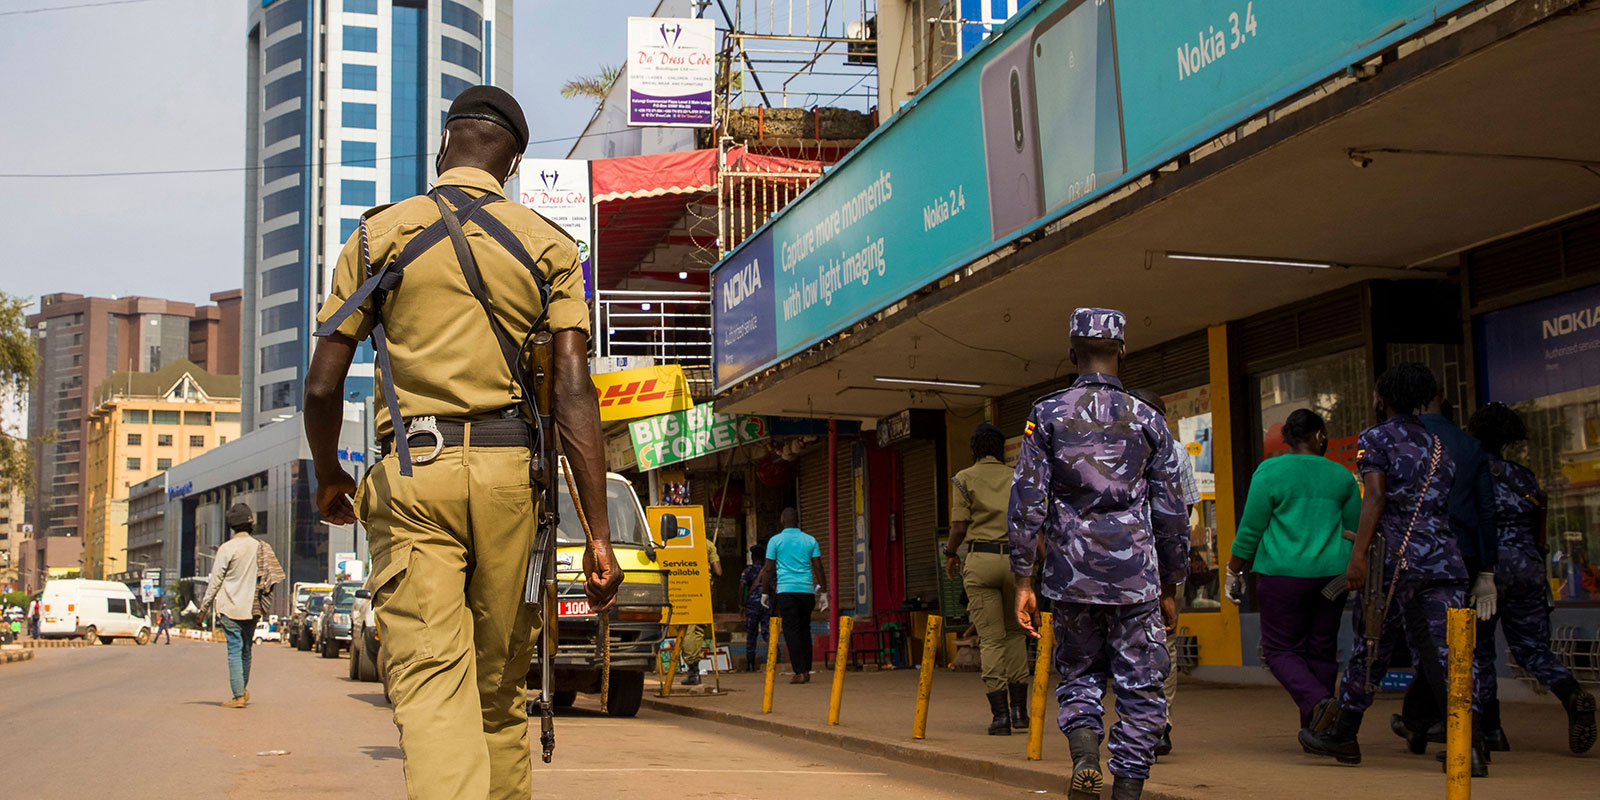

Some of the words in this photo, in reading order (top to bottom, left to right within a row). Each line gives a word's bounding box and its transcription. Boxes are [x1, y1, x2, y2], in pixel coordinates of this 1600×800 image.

[660, 51, 685, 65] Dress
[688, 52, 711, 65] Code
[1177, 26, 1226, 81] Nokia
[1229, 2, 1257, 51] 3.4
[541, 191, 563, 204] Dress
[566, 191, 587, 204] Code
[923, 196, 950, 233] Nokia
[950, 185, 966, 218] 2.4
[781, 229, 814, 275] Capture
[815, 214, 840, 249] more
[841, 169, 893, 230] moments
[723, 258, 762, 313] NOKIA
[782, 282, 801, 322] with
[802, 276, 818, 309] low
[818, 252, 841, 307] light
[842, 235, 886, 286] imaging
[1542, 305, 1600, 340] NOKIA
[597, 378, 666, 407] HL
[633, 413, 680, 446] BIG
[653, 418, 753, 464] FOREX
[663, 559, 698, 568] Services
[667, 568, 700, 576] vailable
